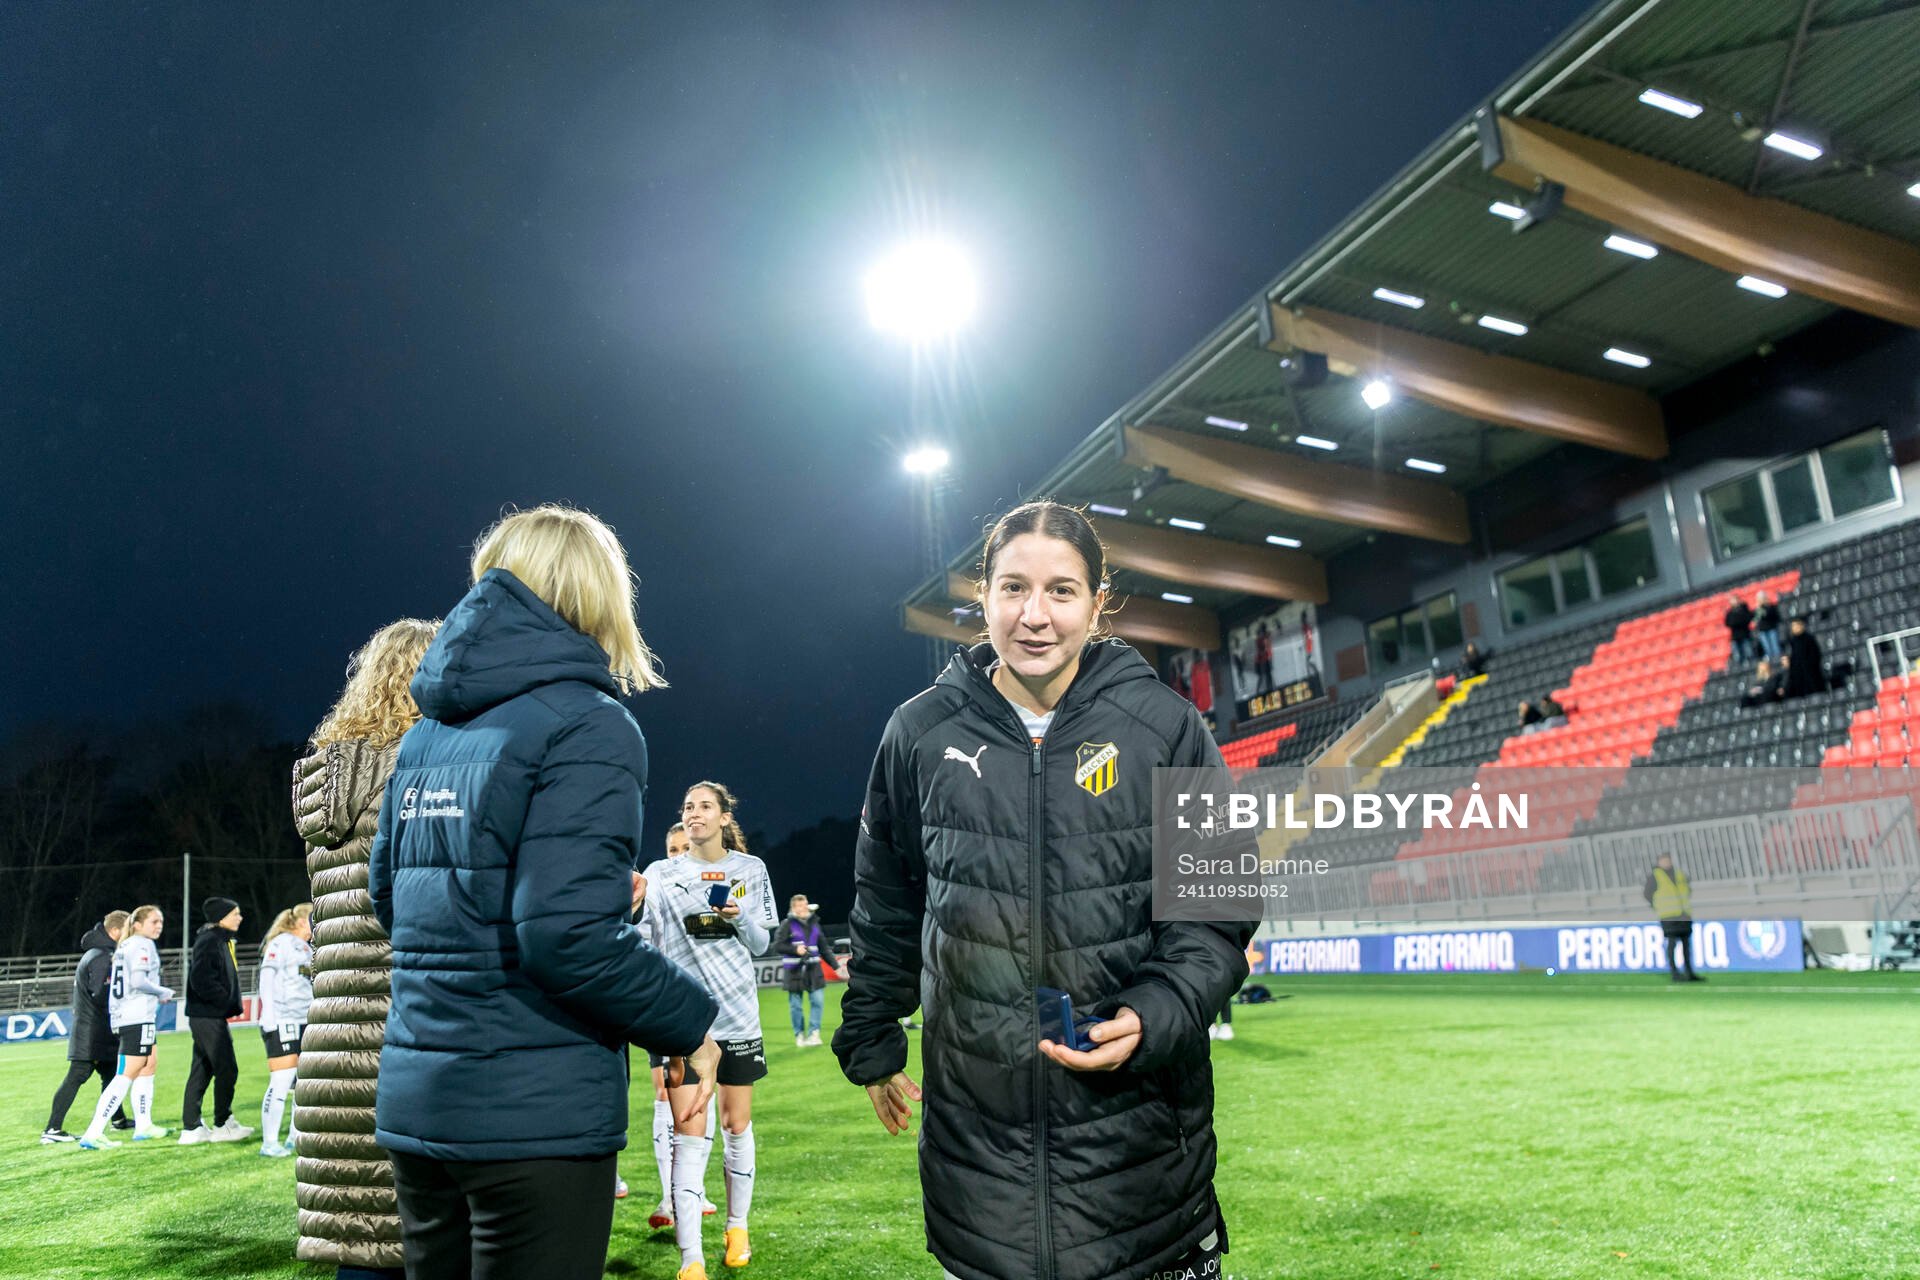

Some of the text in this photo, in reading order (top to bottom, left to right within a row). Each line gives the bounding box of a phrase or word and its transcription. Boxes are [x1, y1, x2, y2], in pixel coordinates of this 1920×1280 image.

[1270, 938, 1361, 972] PERFORMIQ
[1393, 931, 1515, 971] PERFORMIQ
[1557, 921, 1730, 970] PERFORIQ
